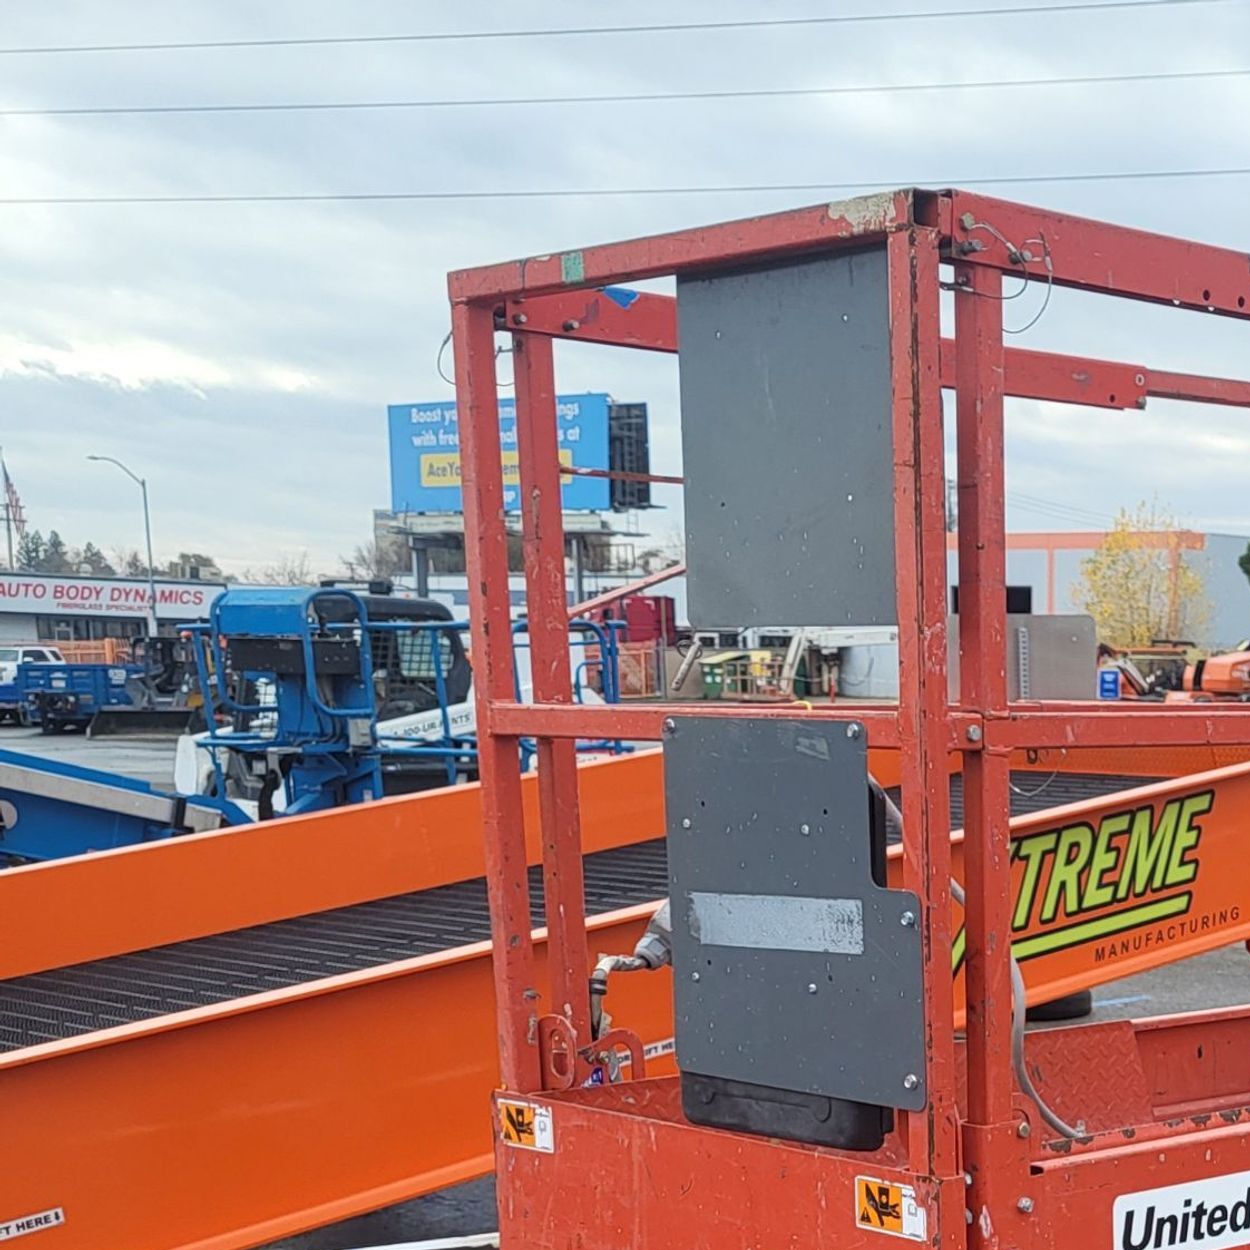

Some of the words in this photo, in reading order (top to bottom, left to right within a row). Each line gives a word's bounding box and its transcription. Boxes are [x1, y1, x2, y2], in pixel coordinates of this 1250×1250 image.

[411, 405, 441, 423] Boost
[411, 429, 437, 448] with
[567, 426, 580, 442] at
[53, 584, 104, 601] BODY
[109, 587, 204, 606] DYNAMICS
[1010, 789, 1215, 931] TREME
[1094, 906, 1241, 962] MANUFACTURING
[16, 1214, 53, 1232] HERE
